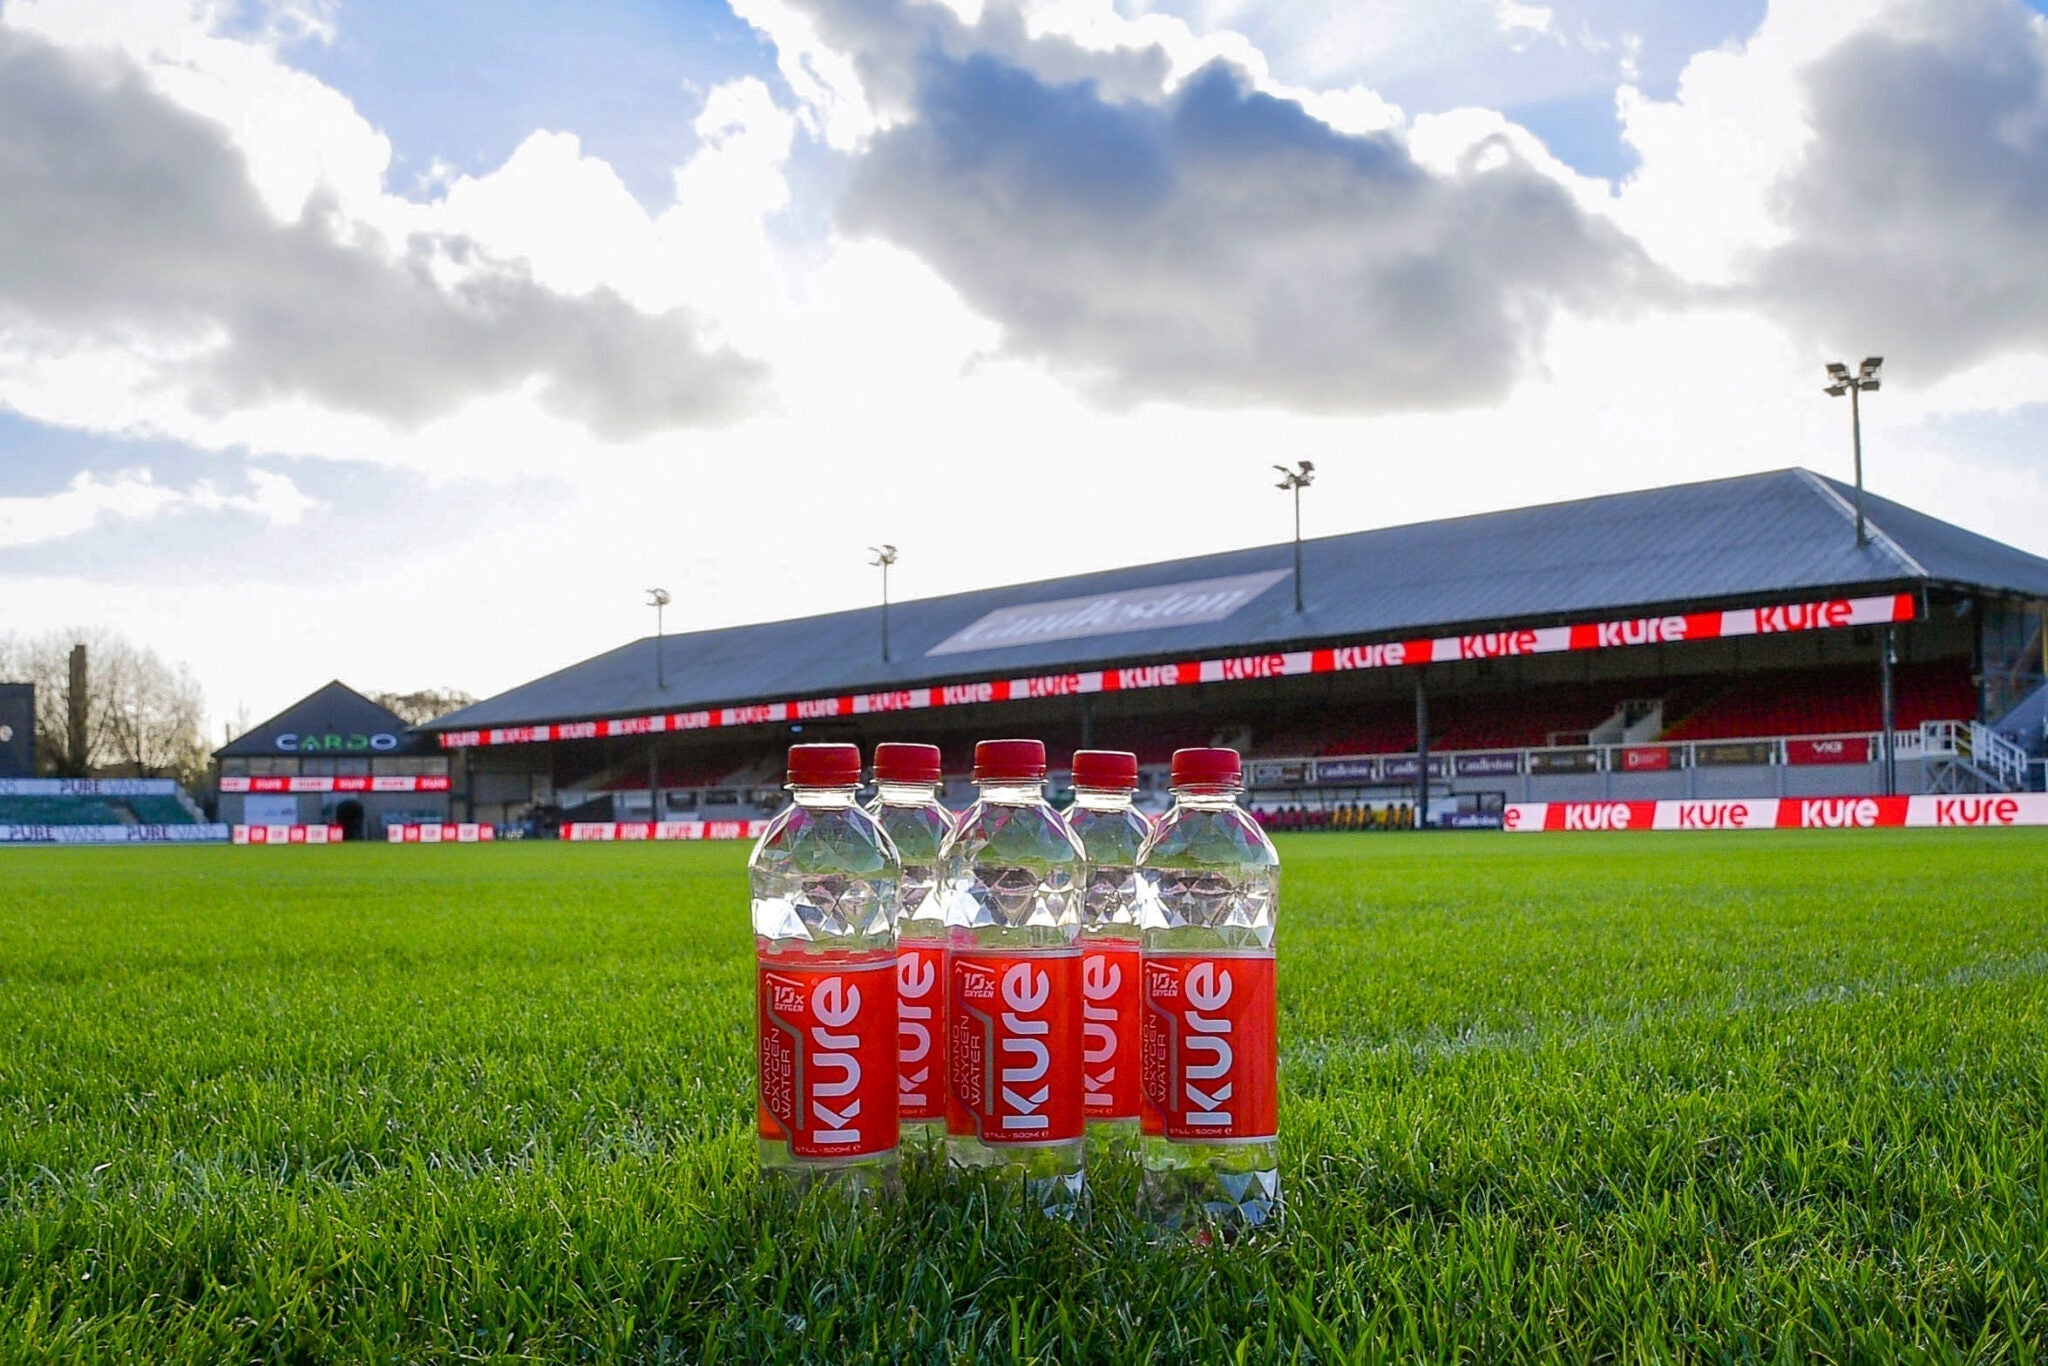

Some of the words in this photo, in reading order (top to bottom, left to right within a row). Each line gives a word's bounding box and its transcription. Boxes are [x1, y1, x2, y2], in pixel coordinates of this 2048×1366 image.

[276, 733, 398, 750] CARDO
[763, 1037, 771, 1095] NANO
[771, 1028, 780, 1113] OXYGEN
[782, 1049, 792, 1120] WATER
[952, 1025, 960, 1082] NANO
[960, 1015, 969, 1099] OXYGEN
[971, 1035, 980, 1106] WATER
[1149, 1014, 1157, 1097] OXYGEN
[1157, 1034, 1166, 1102] WATER
